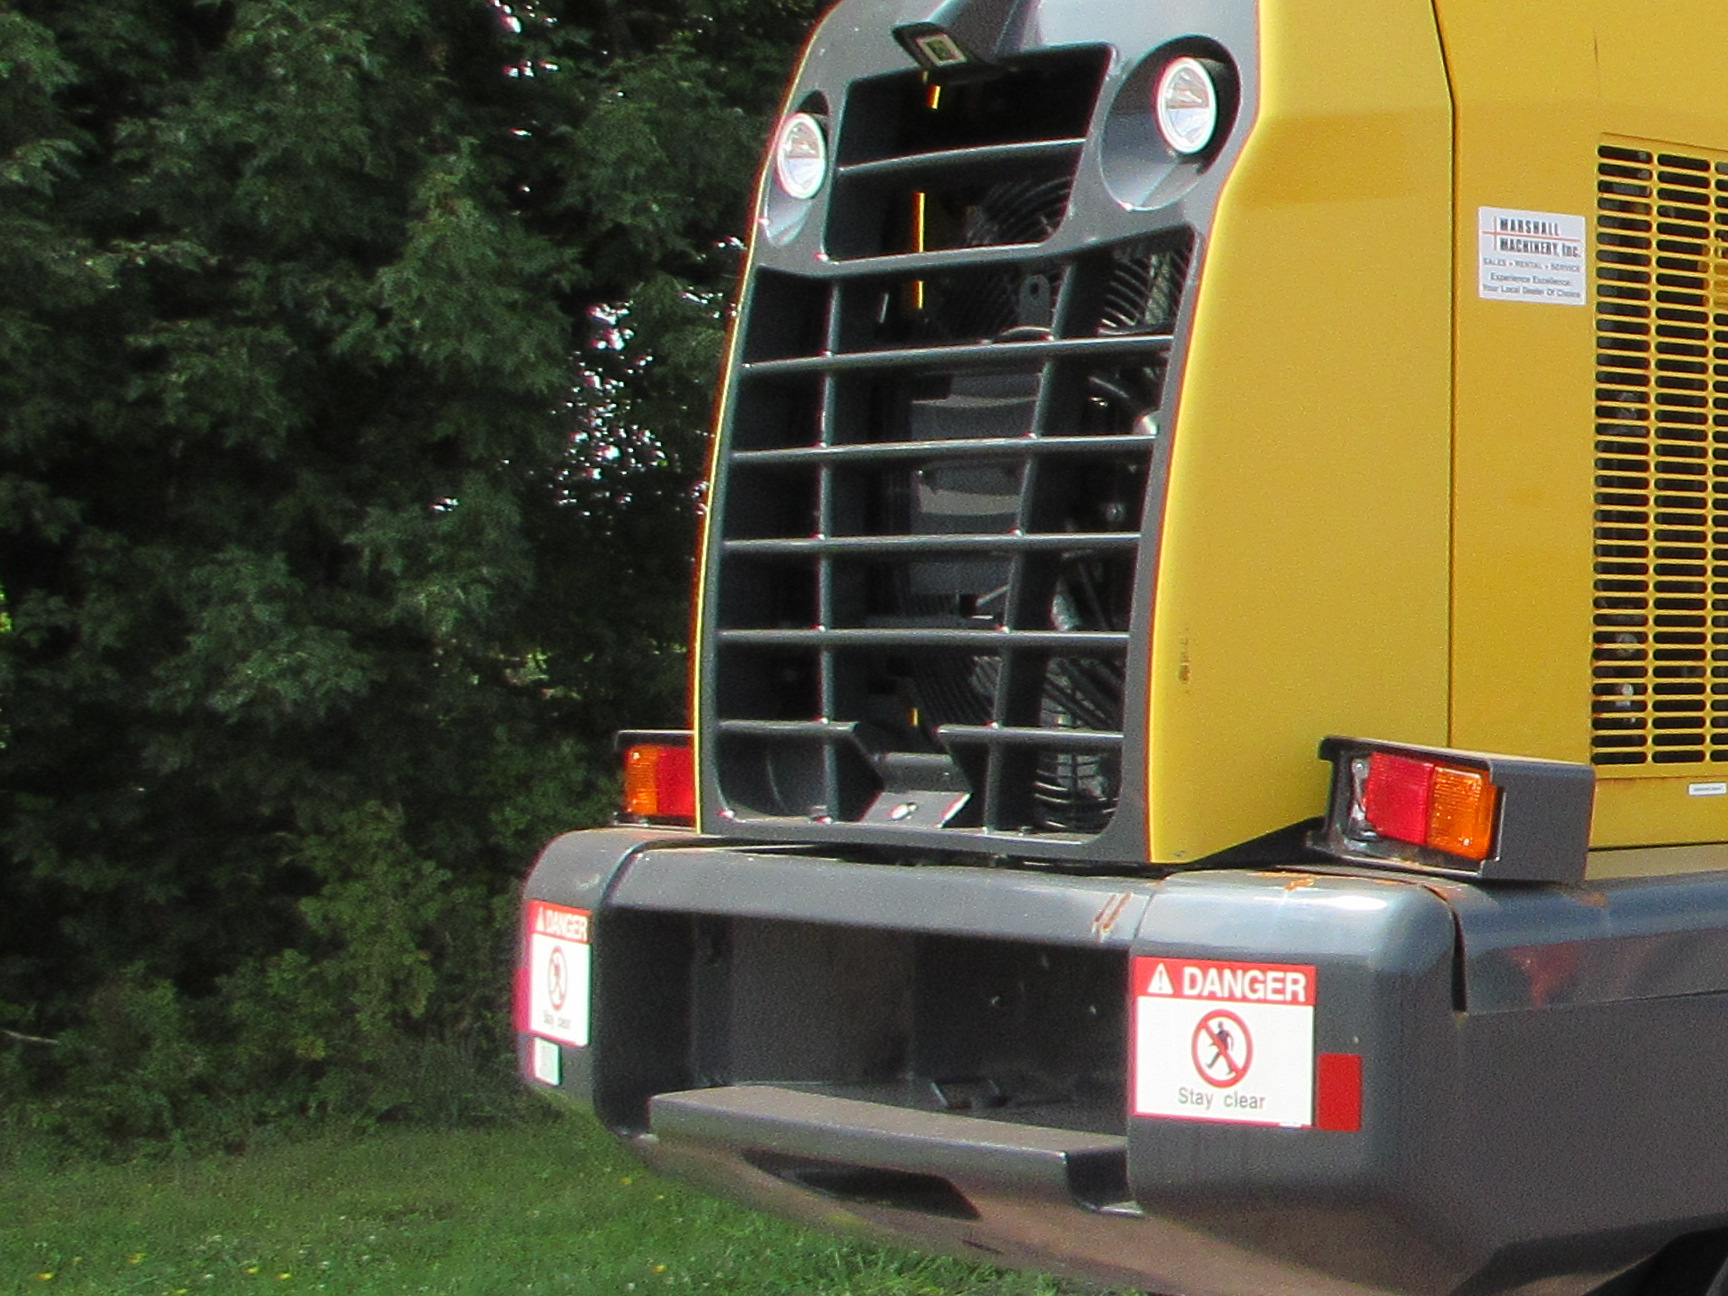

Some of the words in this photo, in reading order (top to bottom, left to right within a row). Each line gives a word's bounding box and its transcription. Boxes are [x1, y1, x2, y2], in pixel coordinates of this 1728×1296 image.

[1500, 217, 1559, 236] MARSHALL
[545, 909, 590, 942] DANGER
[1182, 966, 1308, 1003] DANGER
[1178, 1086, 1214, 1111] Stay
[1223, 1090, 1266, 1110] clear
